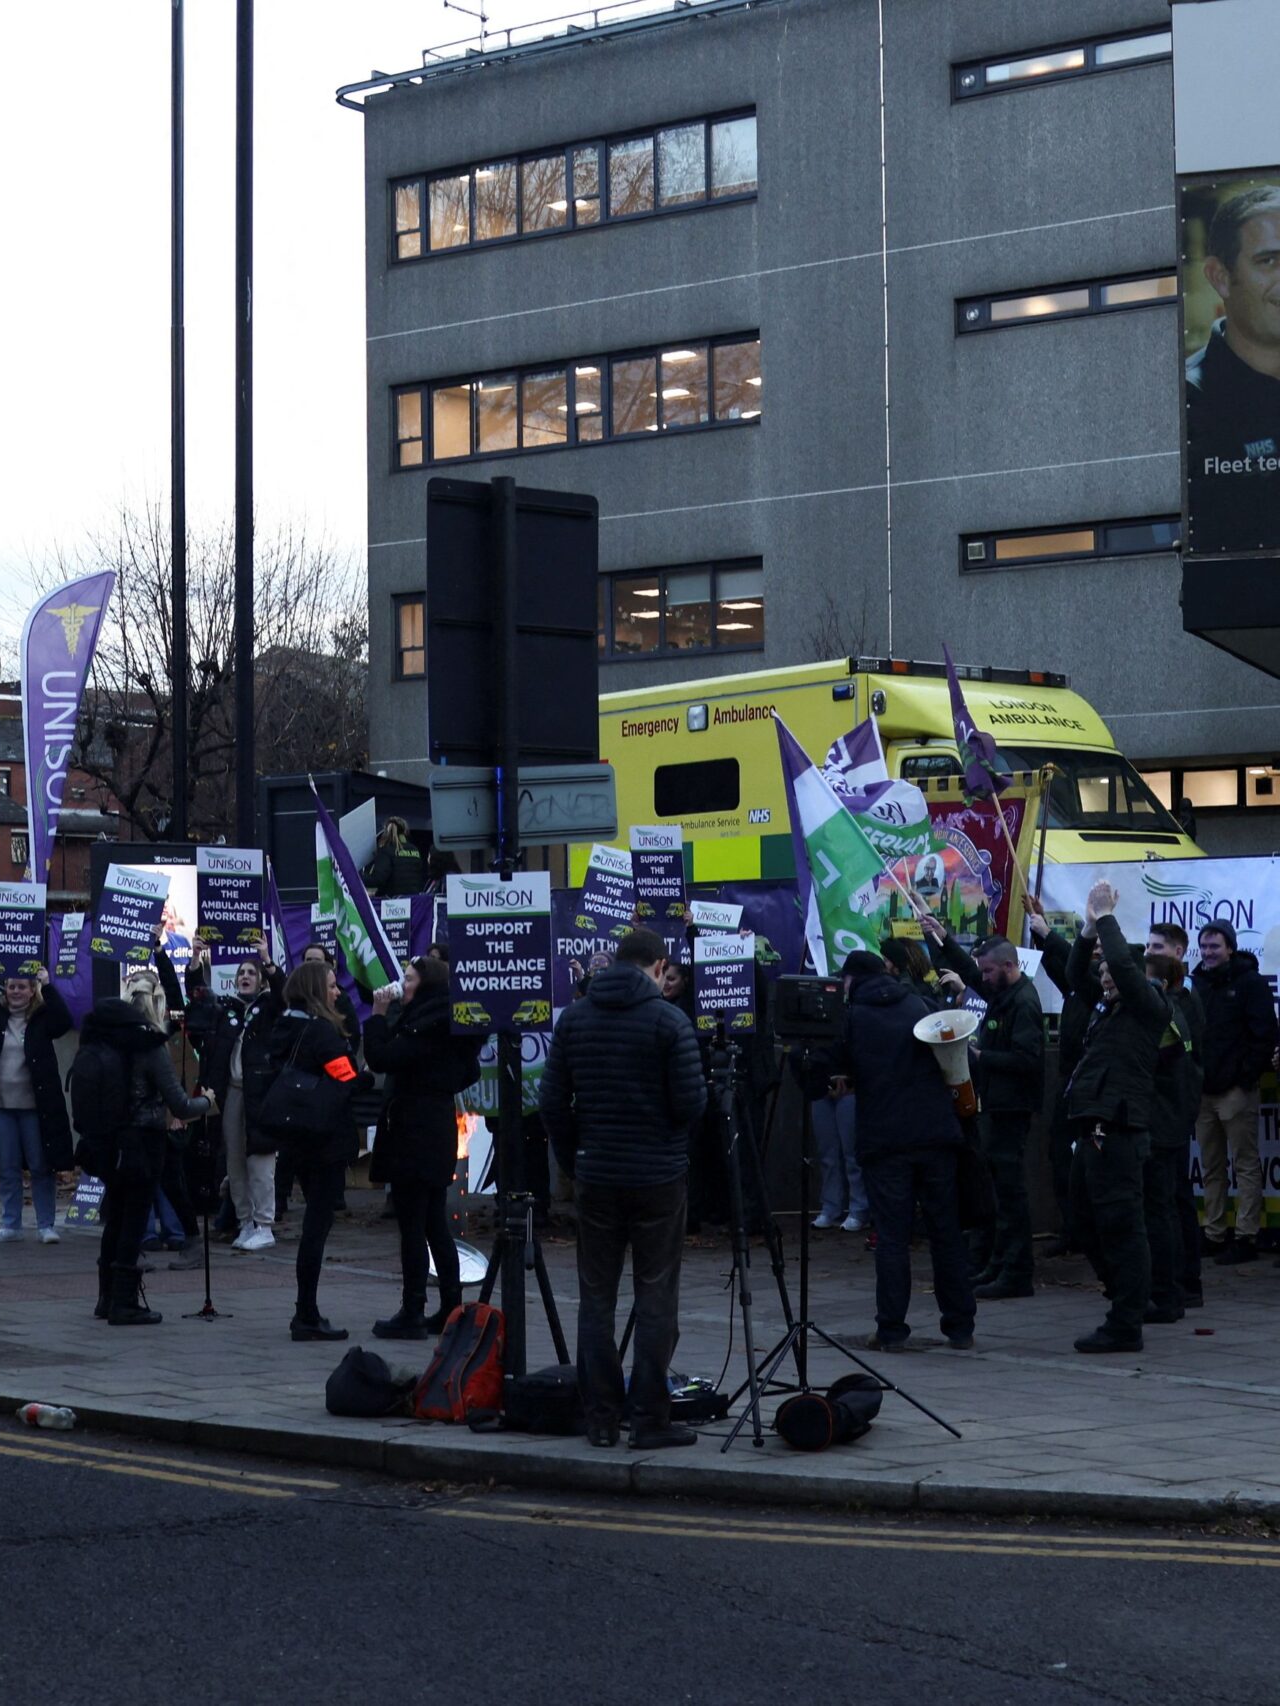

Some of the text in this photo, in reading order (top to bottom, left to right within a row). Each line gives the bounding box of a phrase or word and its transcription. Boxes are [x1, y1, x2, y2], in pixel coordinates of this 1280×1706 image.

[1204, 456, 1252, 475] Fleet
[989, 700, 1058, 713] LONDON
[622, 705, 776, 737] Emergency Ambulance
[989, 714, 1086, 731] AMBULANCE
[749, 809, 770, 823] NHS
[680, 820, 715, 830] Ambulance
[716, 817, 740, 828] Service
[638, 836, 673, 846] UNISON
[208, 858, 251, 871] UNISON
[600, 855, 633, 871] UNISO
[639, 855, 674, 864] SUPPORT
[650, 867, 665, 875] THE
[116, 876, 159, 892] UNISON
[208, 878, 251, 888] SUPPORT
[636, 877, 681, 886] AMBULANCE
[220, 889, 239, 899] THE
[605, 885, 622, 897] THE
[638, 887, 680, 897] WORKERS
[112, 894, 154, 909] SUPPORT
[465, 890, 532, 907] UNISON
[201, 900, 259, 911] AMBULANCE
[584, 902, 634, 921] WORKERS
[122, 907, 139, 918] THE
[203, 911, 257, 922] WORKERS
[696, 911, 733, 923] UNISON
[1150, 899, 1254, 931] UNISON
[5, 923, 22, 932] THE
[99, 923, 151, 942] WORKERS
[465, 922, 532, 937] SUPPORT
[485, 941, 514, 954] THE
[557, 938, 595, 955] FROM
[705, 945, 744, 957] UNISON
[455, 958, 546, 974] AMBULANCE
[705, 965, 744, 975] SUPPORT
[459, 976, 543, 992] WORKERS
[715, 976, 733, 985] THE
[698, 986, 751, 998] AMBULANCE
[700, 998, 749, 1009] WORKERS
